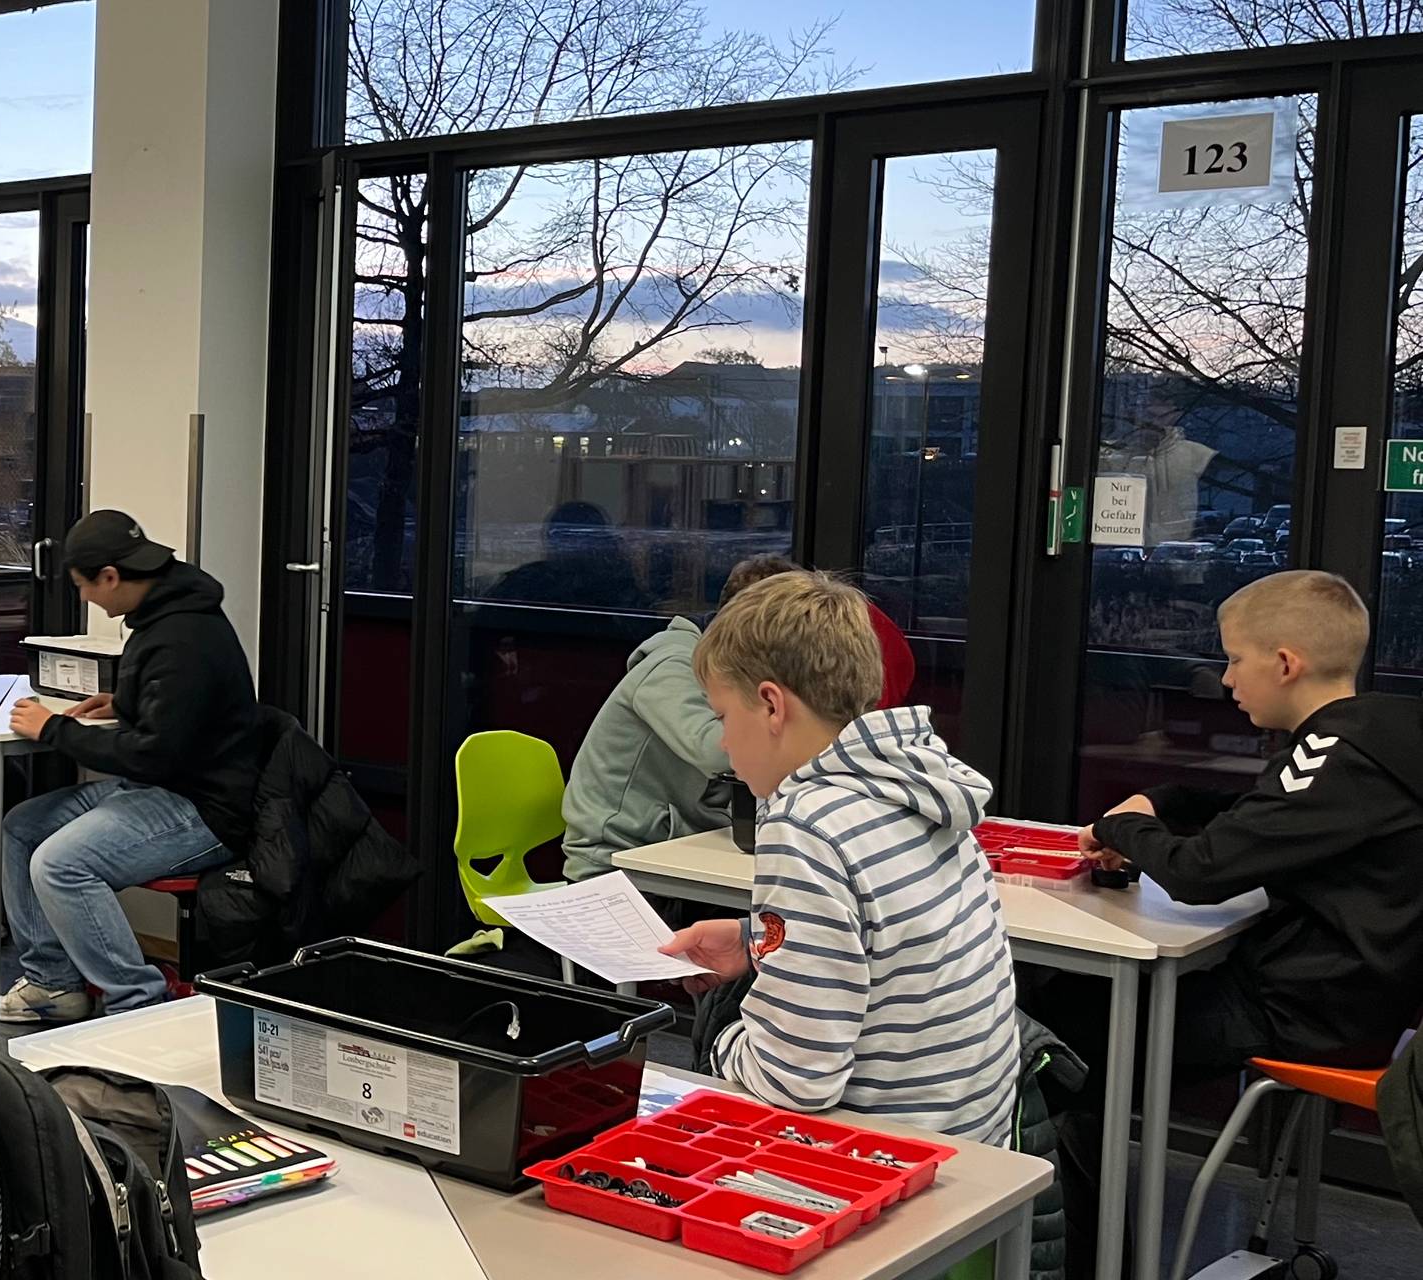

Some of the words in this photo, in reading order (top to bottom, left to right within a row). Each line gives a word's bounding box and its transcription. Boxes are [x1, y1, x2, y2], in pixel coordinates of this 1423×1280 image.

[1182, 142, 1248, 176] 123
[1111, 482, 1132, 492] Nur
[1111, 496, 1127, 506] bei
[1100, 509, 1137, 520] Gefahr
[1094, 523, 1141, 535] benutzen
[258, 1021, 279, 1036] 10-21
[258, 1044, 269, 1056] 541
[362, 1082, 372, 1099] 8
[417, 1130, 452, 1145] education
